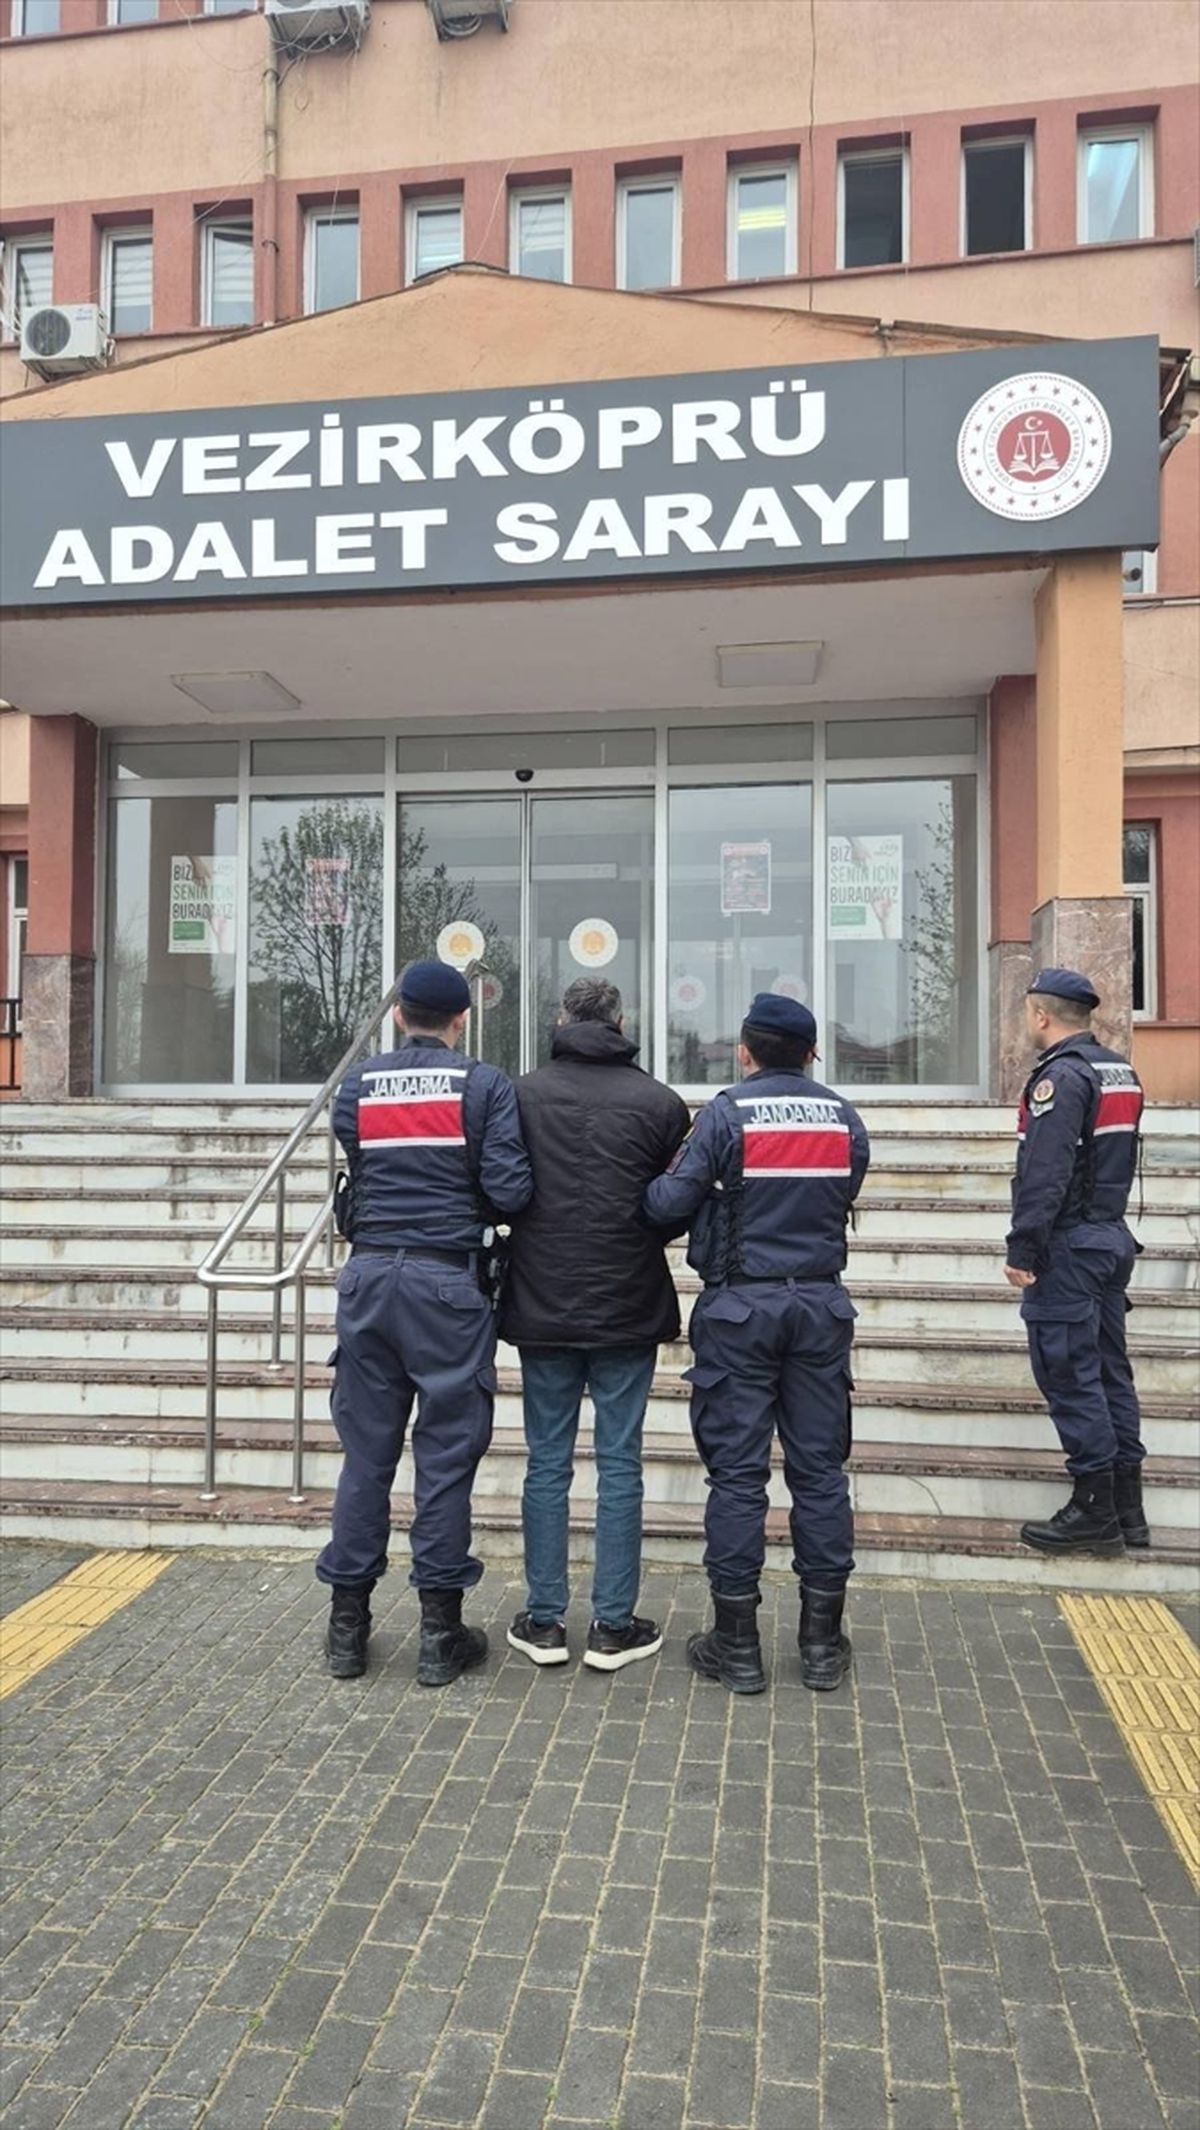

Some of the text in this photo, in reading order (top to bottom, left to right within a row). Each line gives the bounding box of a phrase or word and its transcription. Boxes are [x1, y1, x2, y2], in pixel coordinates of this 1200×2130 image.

[104, 379, 827, 499] VEZİRKÖPRÜ
[33, 477, 909, 588] ADALET SARAYI
[369, 1075, 452, 1097] JANDARMA
[751, 1103, 840, 1123] JANDARMA
